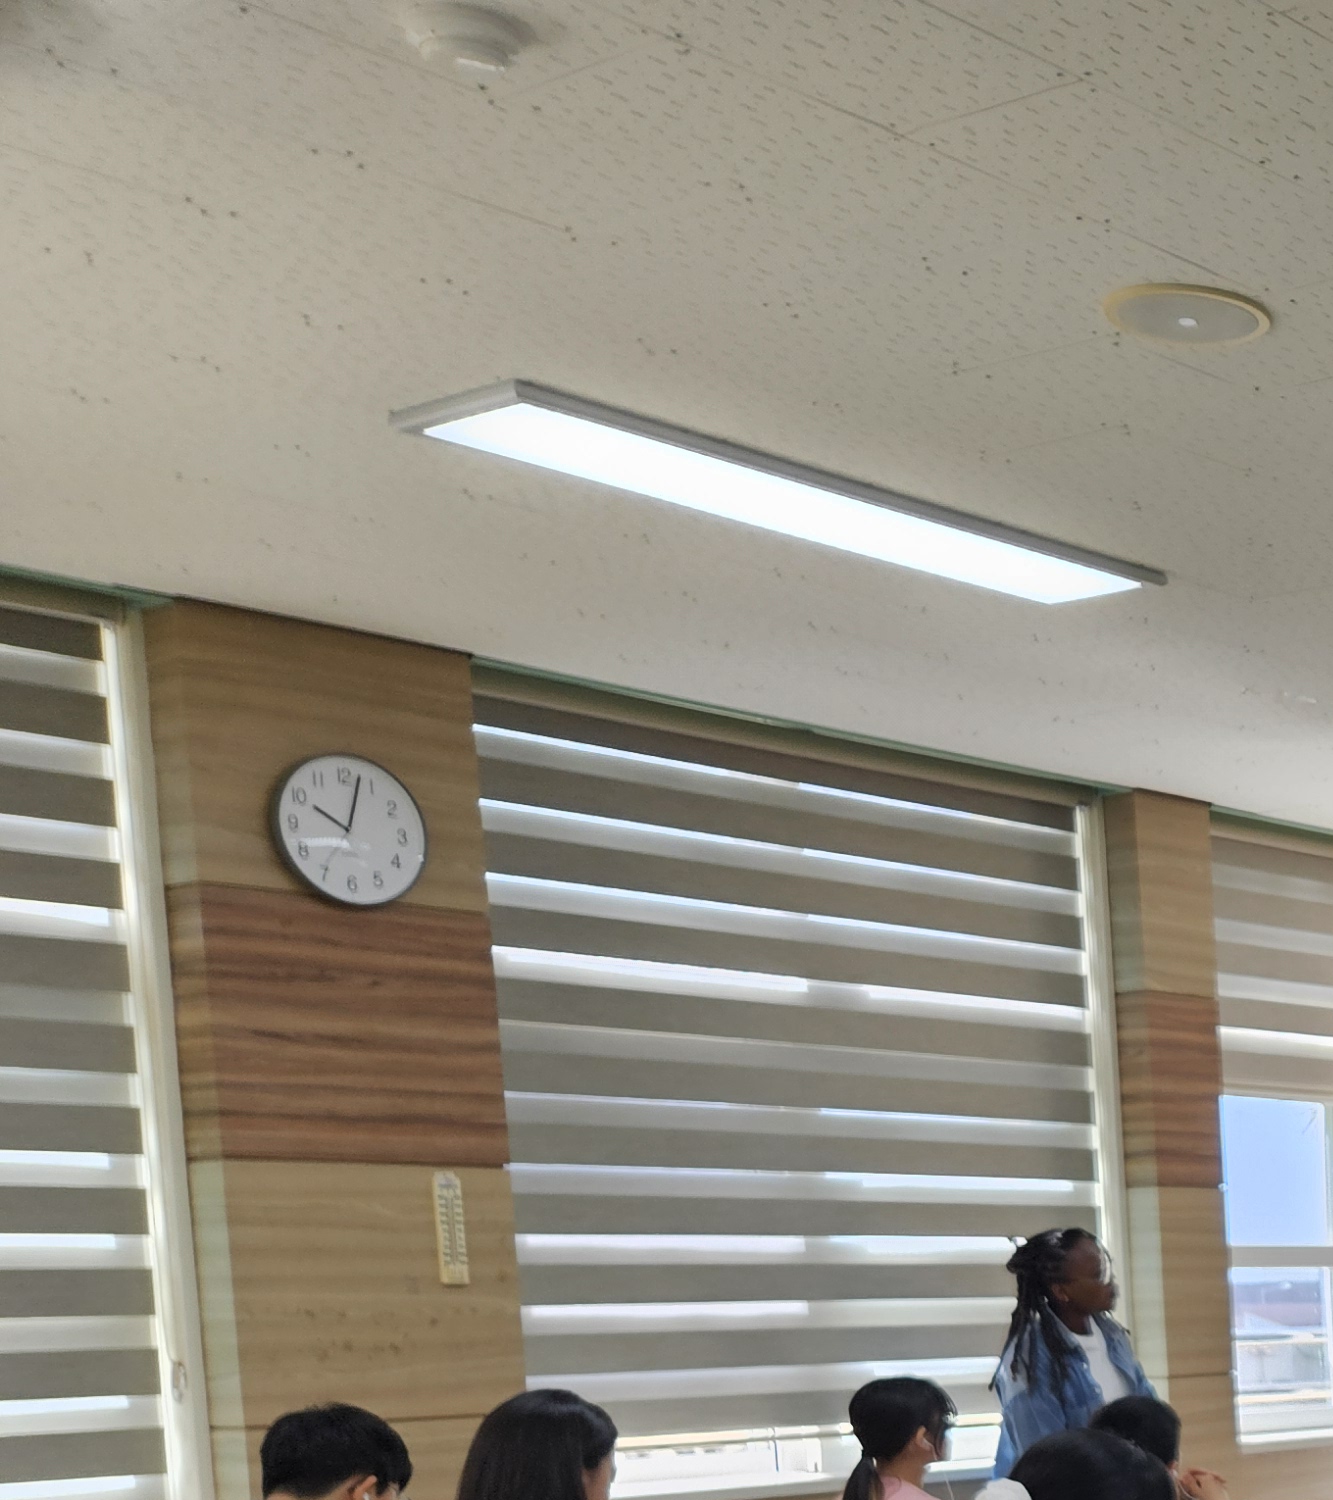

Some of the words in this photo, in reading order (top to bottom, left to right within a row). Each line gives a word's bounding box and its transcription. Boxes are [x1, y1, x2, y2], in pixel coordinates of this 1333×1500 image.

[312, 770, 324, 788] 11
[337, 766, 352, 786] 12
[292, 786, 307, 804] 10
[387, 800, 397, 818] 2
[288, 814, 298, 831] 9
[397, 829, 408, 846] 3
[298, 841, 309, 858] 8
[391, 853, 401, 869] 4
[319, 864, 329, 881] 7
[373, 870, 384, 887] 5
[347, 875, 357, 893] 6
